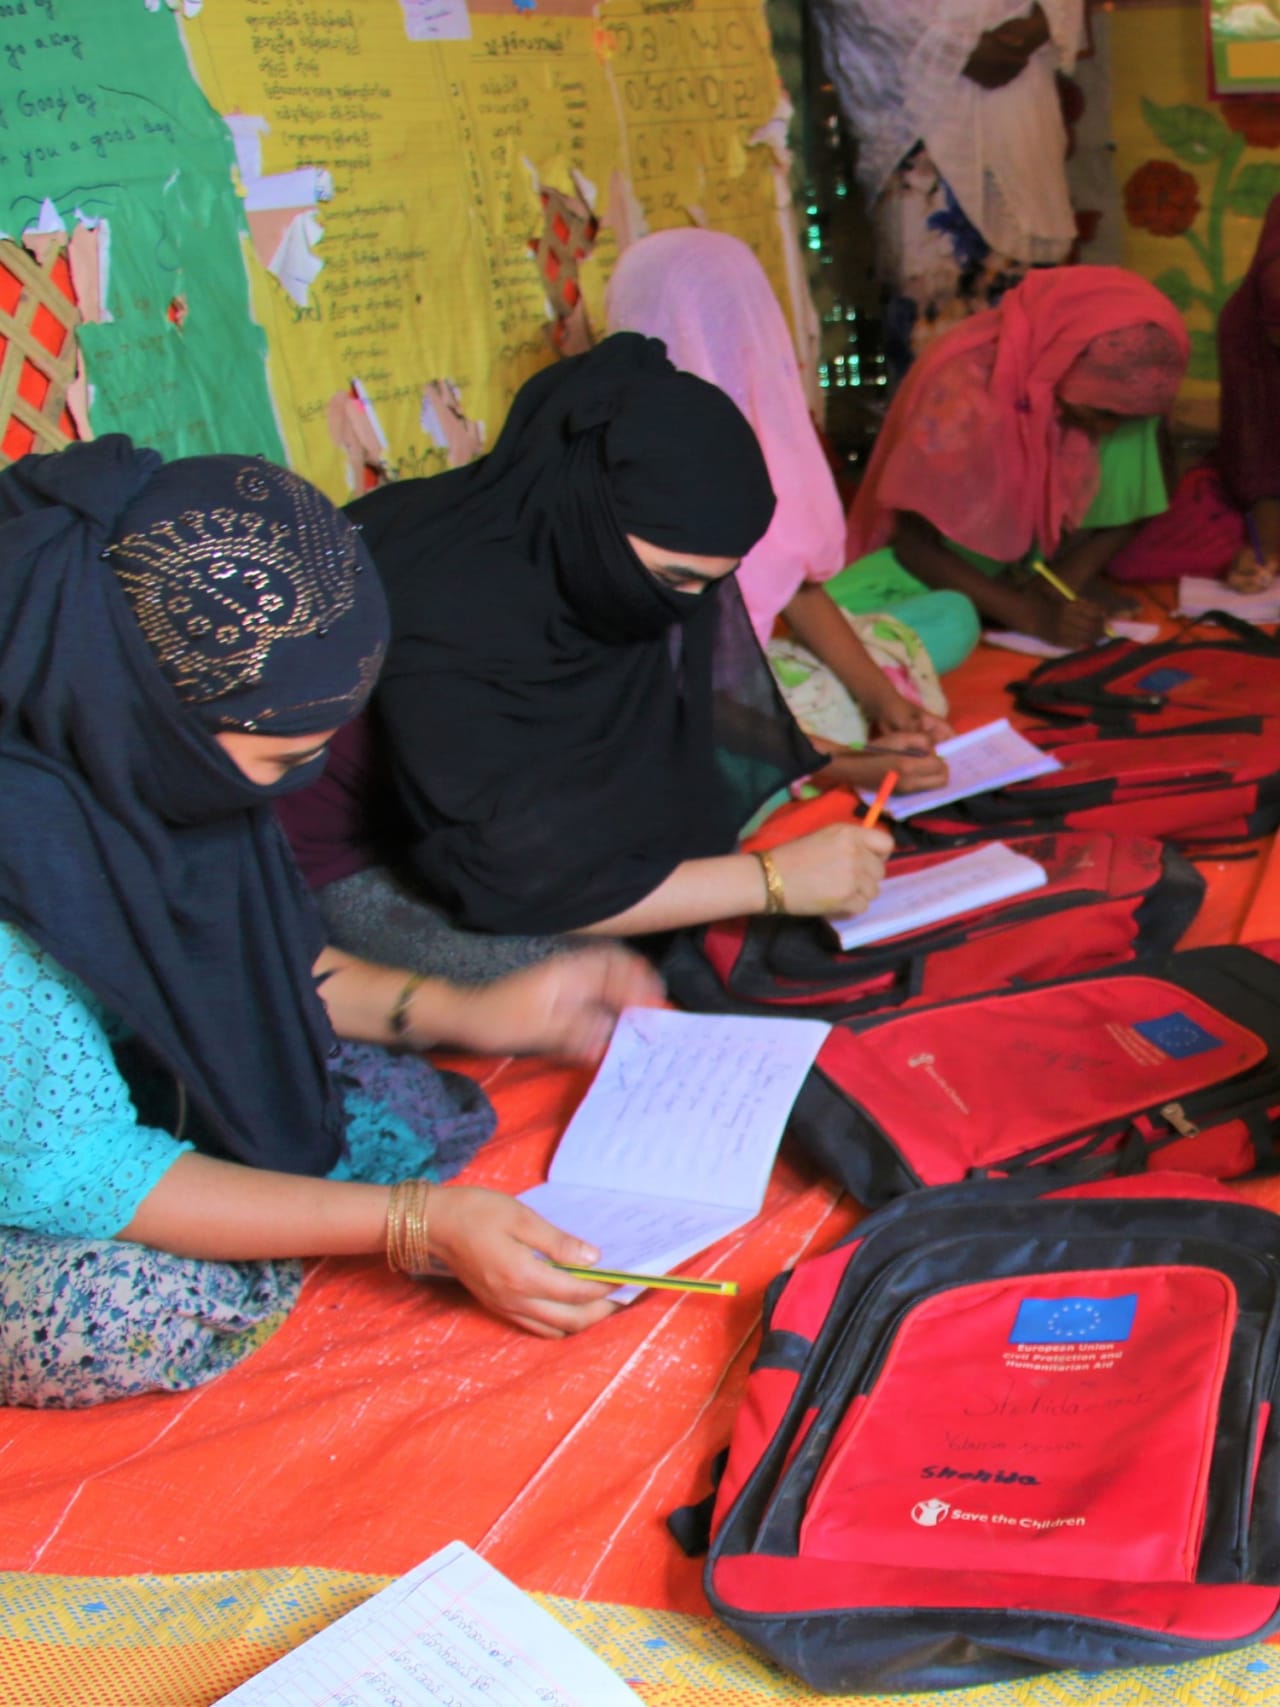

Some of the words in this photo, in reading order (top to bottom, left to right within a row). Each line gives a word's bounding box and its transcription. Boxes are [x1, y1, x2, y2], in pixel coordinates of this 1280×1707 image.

[20, 148, 61, 178] you
[70, 141, 80, 152] a
[1017, 1343, 1075, 1354] European
[1079, 1343, 1115, 1352] Union
[1032, 1353, 1096, 1363] Protection
[1100, 1351, 1123, 1360] and
[1005, 1360, 1090, 1372] Humanitarian
[1094, 1360, 1115, 1370] Aid
[951, 1509, 988, 1523] Save
[991, 1513, 1017, 1526] the
[1019, 1516, 1086, 1530] Children
